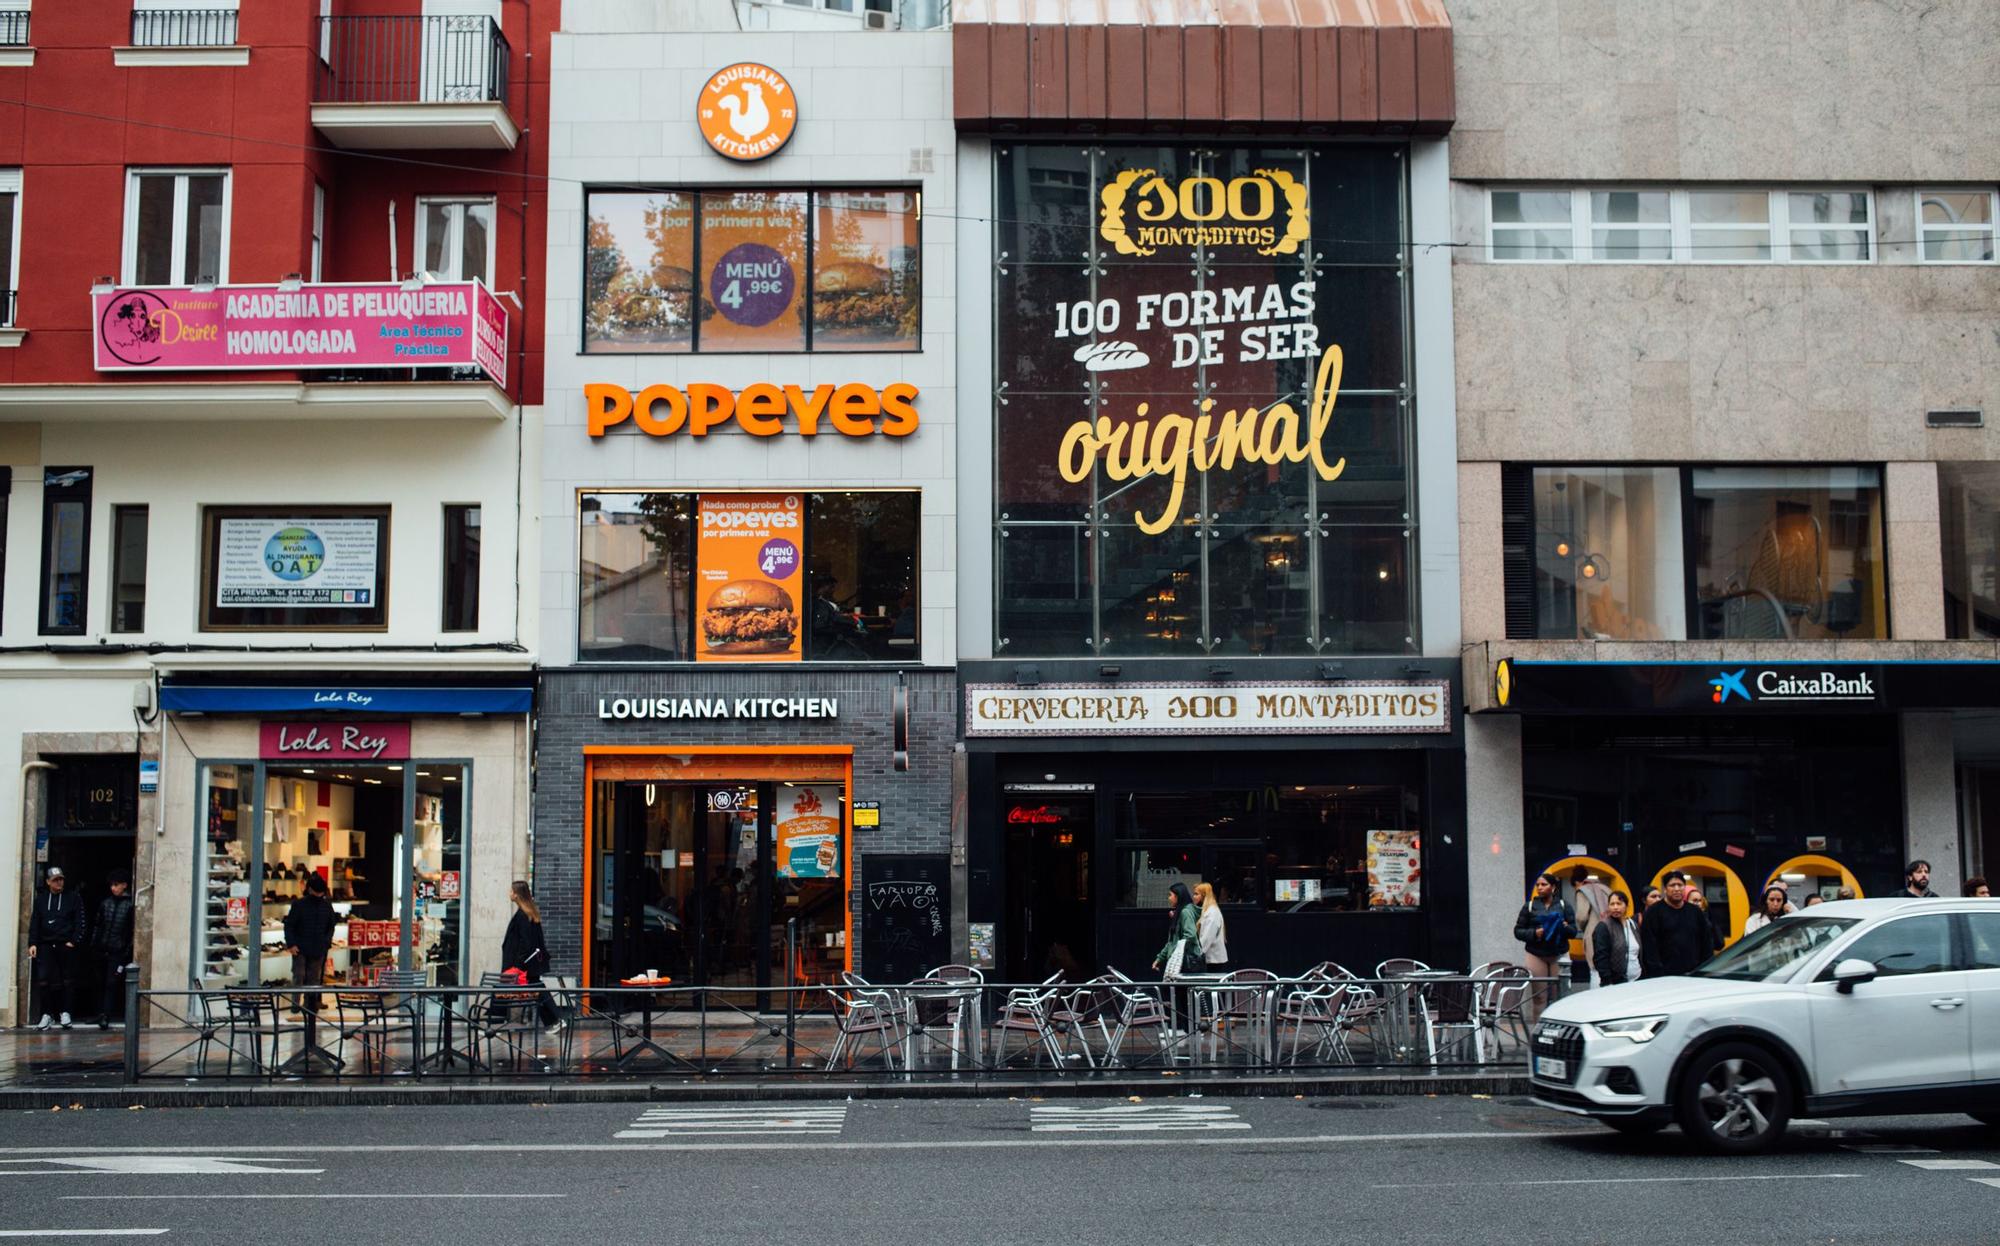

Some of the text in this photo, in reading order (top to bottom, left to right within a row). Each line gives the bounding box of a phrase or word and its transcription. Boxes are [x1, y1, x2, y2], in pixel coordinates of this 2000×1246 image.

[709, 66, 785, 95] LOUISIANA
[702, 109, 793, 119] 19 72
[714, 133, 780, 155] KITCHEN
[665, 214, 792, 230] por primera vez
[1137, 226, 1275, 246] MONTADITOS
[726, 258, 781, 278] MENÚ
[172, 299, 219, 310] Instituto
[225, 294, 320, 319] ACADEMIA
[324, 294, 349, 317] DE
[353, 291, 468, 320] PELUQUERIA
[1054, 281, 1316, 338] 100 FORMAS
[379, 321, 463, 337] Área Técnico
[227, 329, 356, 355] HOMOLOGADA
[394, 343, 449, 356] Práctica
[1172, 322, 1321, 368] DE SER
[1058, 343, 1346, 535] original
[703, 501, 725, 509] Nada
[751, 501, 781, 510] probar
[703, 530, 718, 538] por
[720, 529, 754, 538] primera
[765, 546, 793, 556] MENÚ
[222, 588, 240, 596] CITA
[1757, 671, 1875, 695] CaixaBank
[314, 691, 372, 705] Lola Rey
[599, 698, 837, 719] LOUISIANA KITCHEN
[978, 695, 1149, 724] CERVECERIA
[1256, 693, 1439, 719] MONTADITOS
[279, 726, 387, 758] Lola Rey
[90, 789, 114, 802] 102
